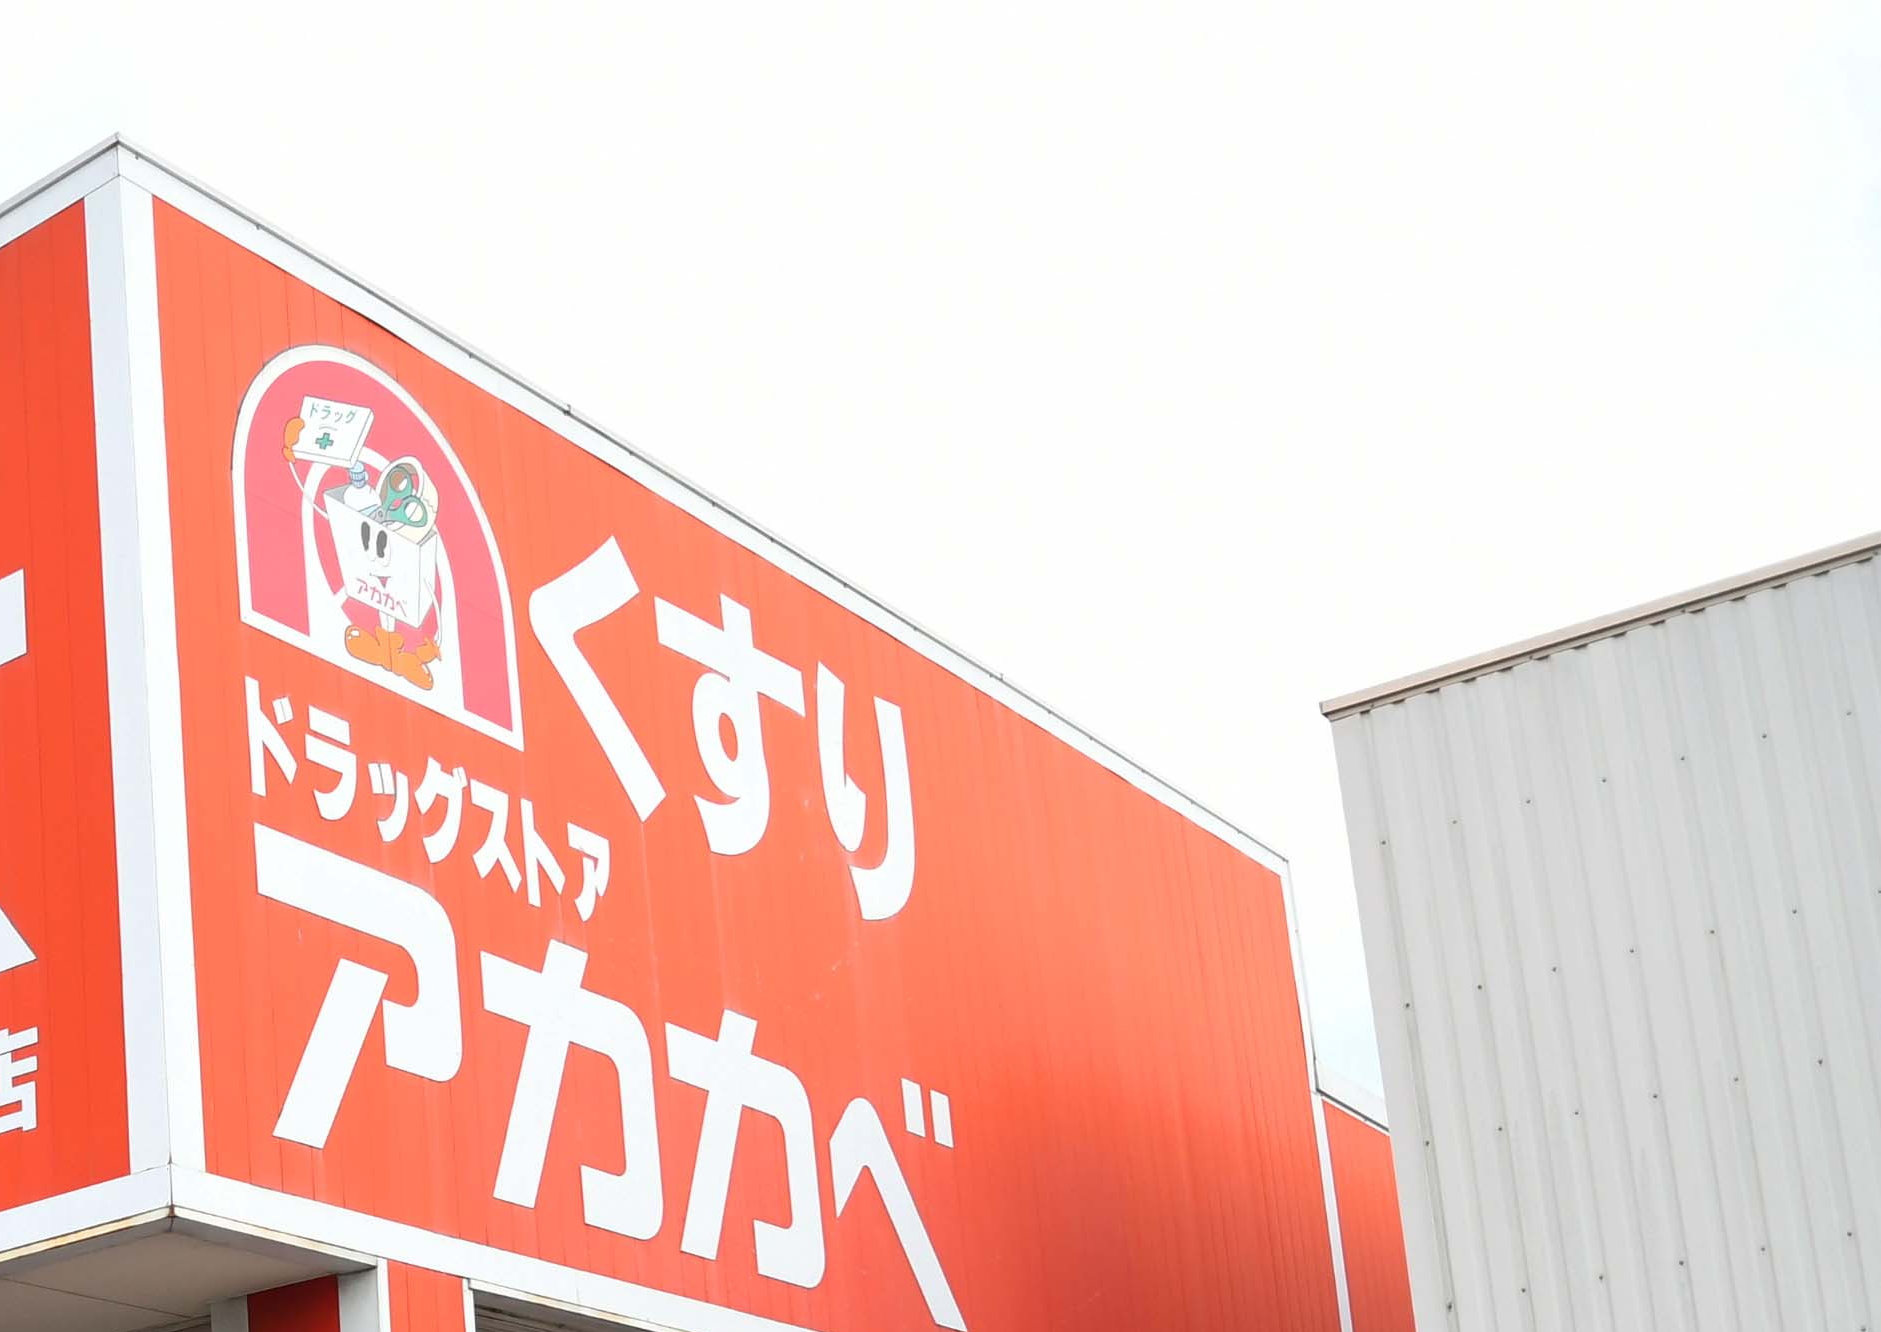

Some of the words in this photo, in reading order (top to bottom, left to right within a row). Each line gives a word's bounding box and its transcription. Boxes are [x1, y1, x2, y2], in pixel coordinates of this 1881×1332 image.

[309, 403, 358, 424] ドラッグ
[356, 577, 408, 618] アカカベ
[245, 674, 611, 922] ドラッグストア
[529, 535, 916, 921] くすり
[254, 823, 968, 1332] アカカベ
